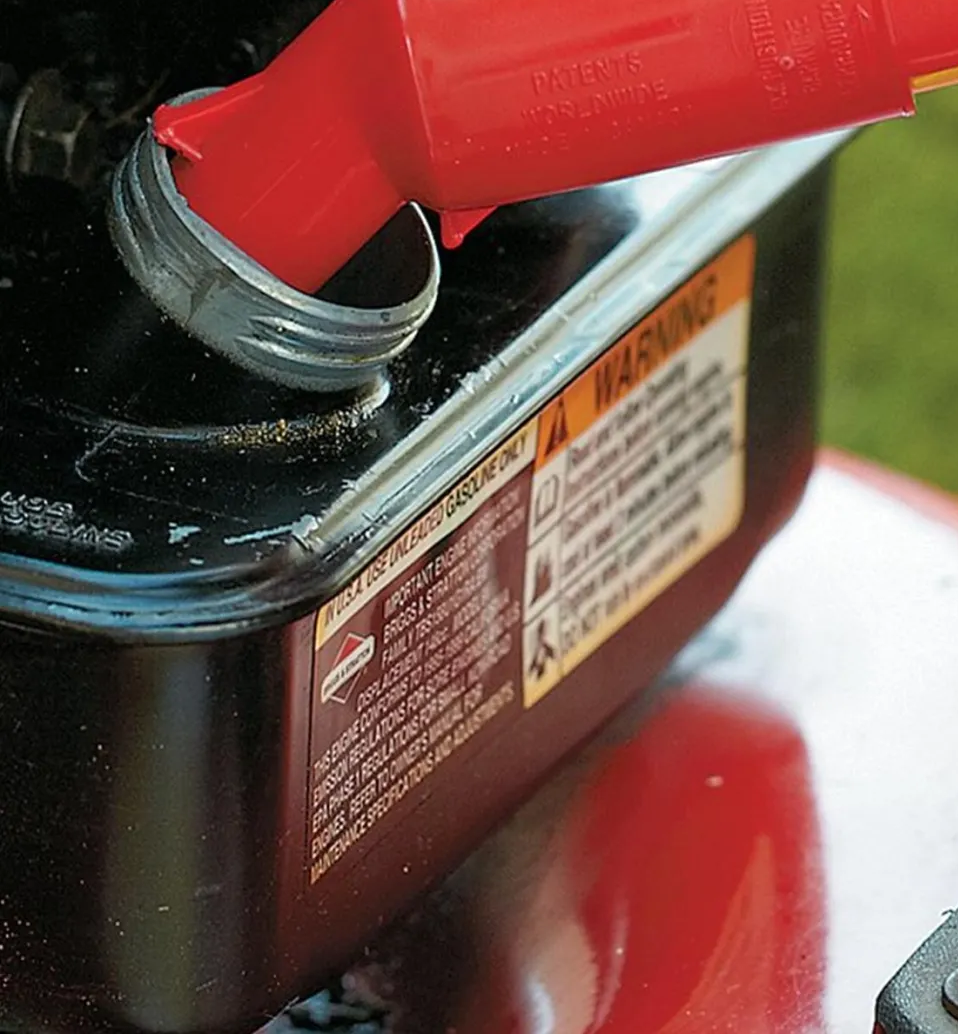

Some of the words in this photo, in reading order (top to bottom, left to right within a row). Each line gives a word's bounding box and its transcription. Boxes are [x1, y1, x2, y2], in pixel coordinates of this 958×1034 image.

[531, 51, 643, 95] PATENTS
[594, 270, 716, 412] WARNING
[366, 558, 390, 587] USE
[389, 506, 444, 567] UNLEADED
[446, 460, 497, 518] GASOLINE
[499, 432, 527, 471] ONLY
[383, 599, 416, 646] BRIGGS
[425, 555, 468, 610] STRATTON
[384, 560, 433, 621] IMPORTANT
[434, 533, 466, 578] ENGINE
[356, 640, 423, 714] DISPLACEMENT
[382, 626, 413, 670] FAMILY
[313, 754, 348, 808] EMISSION
[349, 699, 405, 770] REGULATIONS
[328, 771, 355, 817] PHASE
[360, 711, 418, 784] REGULATIONS
[331, 717, 359, 765] ENGINE
[360, 675, 407, 733] CONFORMS
[310, 811, 366, 885] MAINTENANCE
[366, 747, 434, 830] SPECIFICATIONS
[349, 777, 376, 820] REFER
